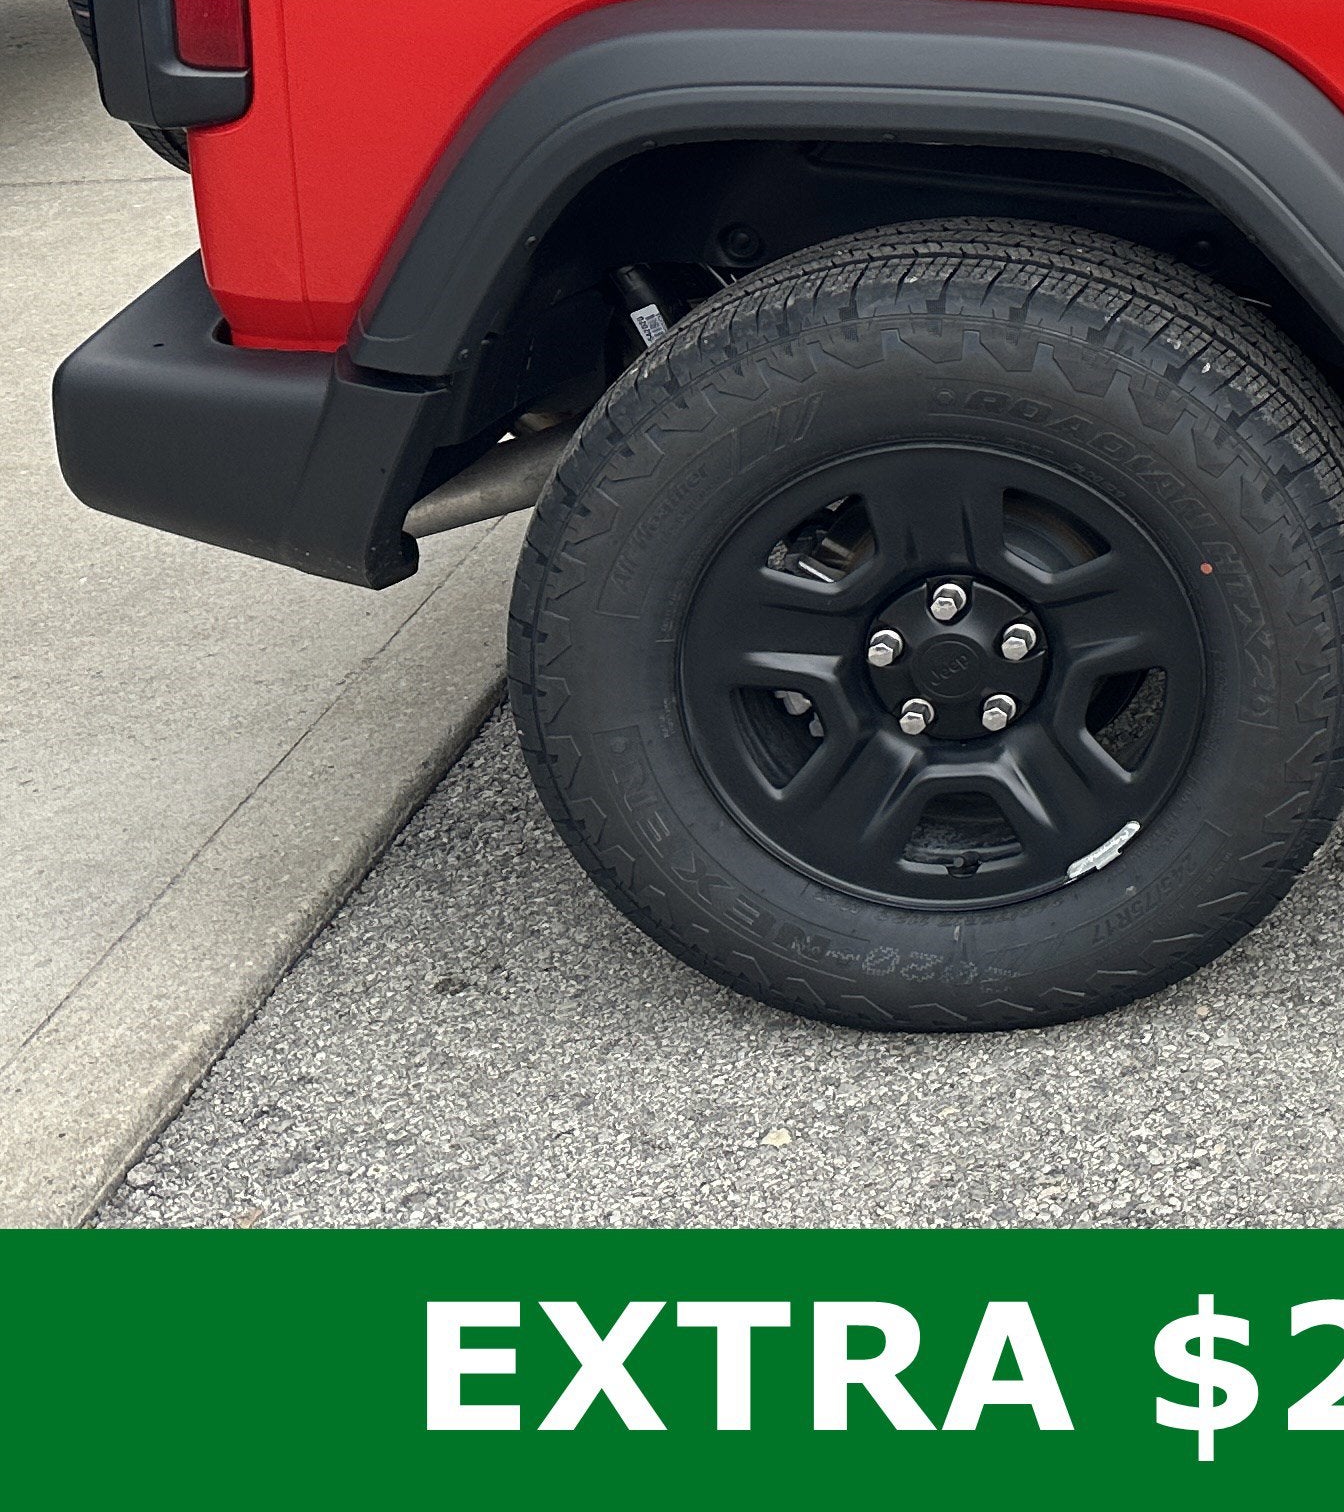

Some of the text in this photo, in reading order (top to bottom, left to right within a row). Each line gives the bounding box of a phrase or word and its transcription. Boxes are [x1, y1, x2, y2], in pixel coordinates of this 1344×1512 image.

[964, 389, 1219, 530] ROADIAN
[930, 655, 968, 686] Jeep
[611, 754, 831, 966] NEXEN
